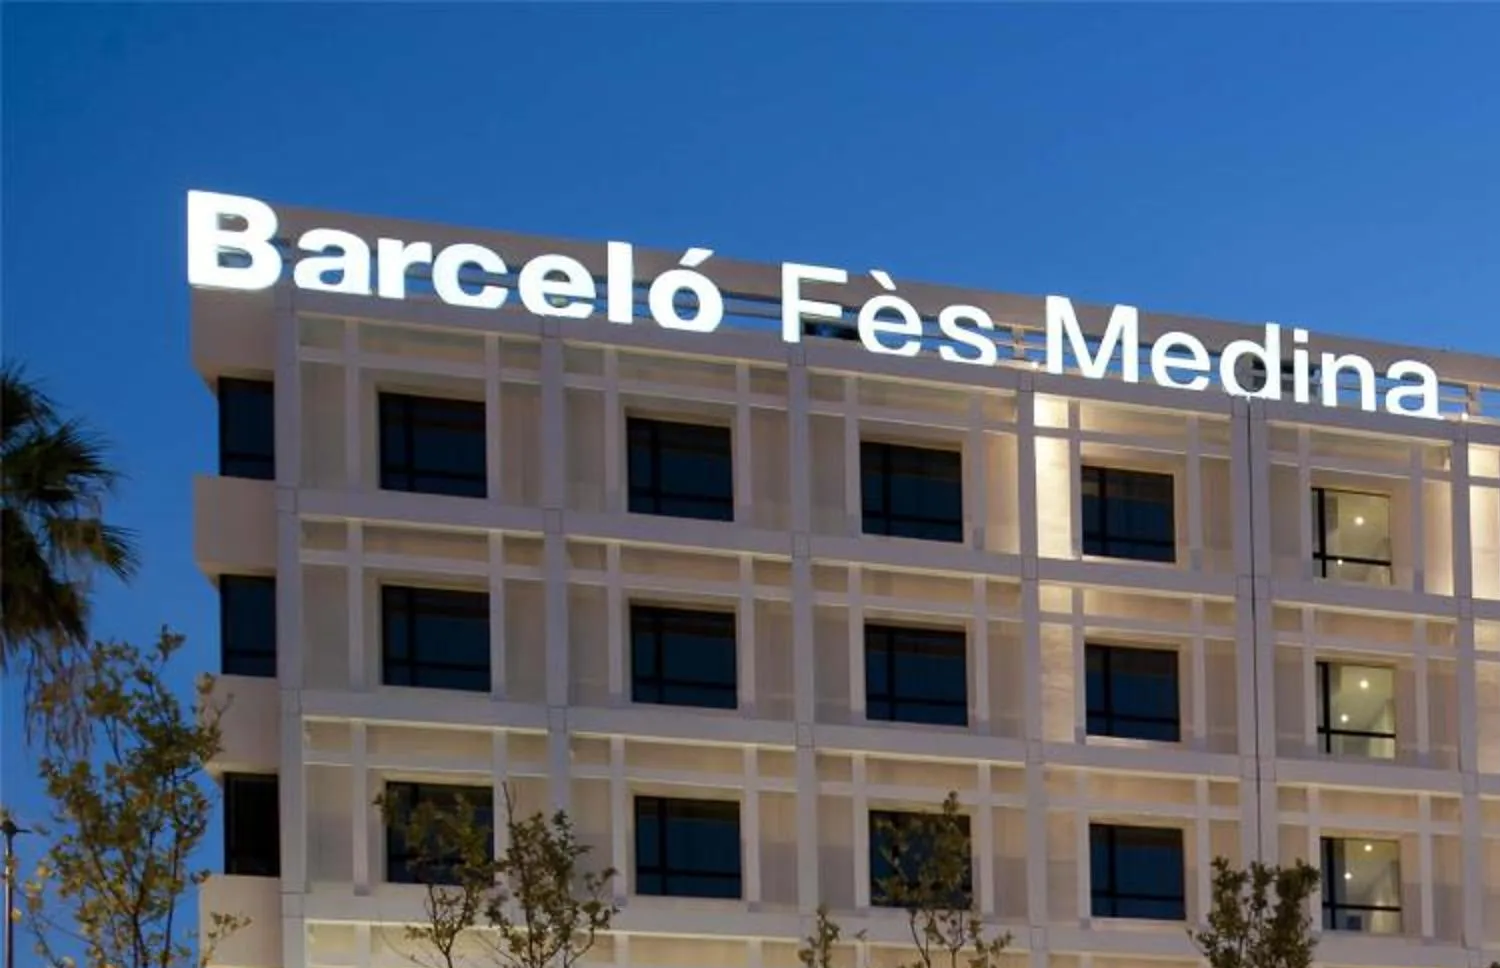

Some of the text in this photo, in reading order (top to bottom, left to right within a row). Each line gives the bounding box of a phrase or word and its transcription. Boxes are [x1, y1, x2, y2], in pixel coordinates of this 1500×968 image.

[187, 190, 1444, 422] Barceló Fès Medina
